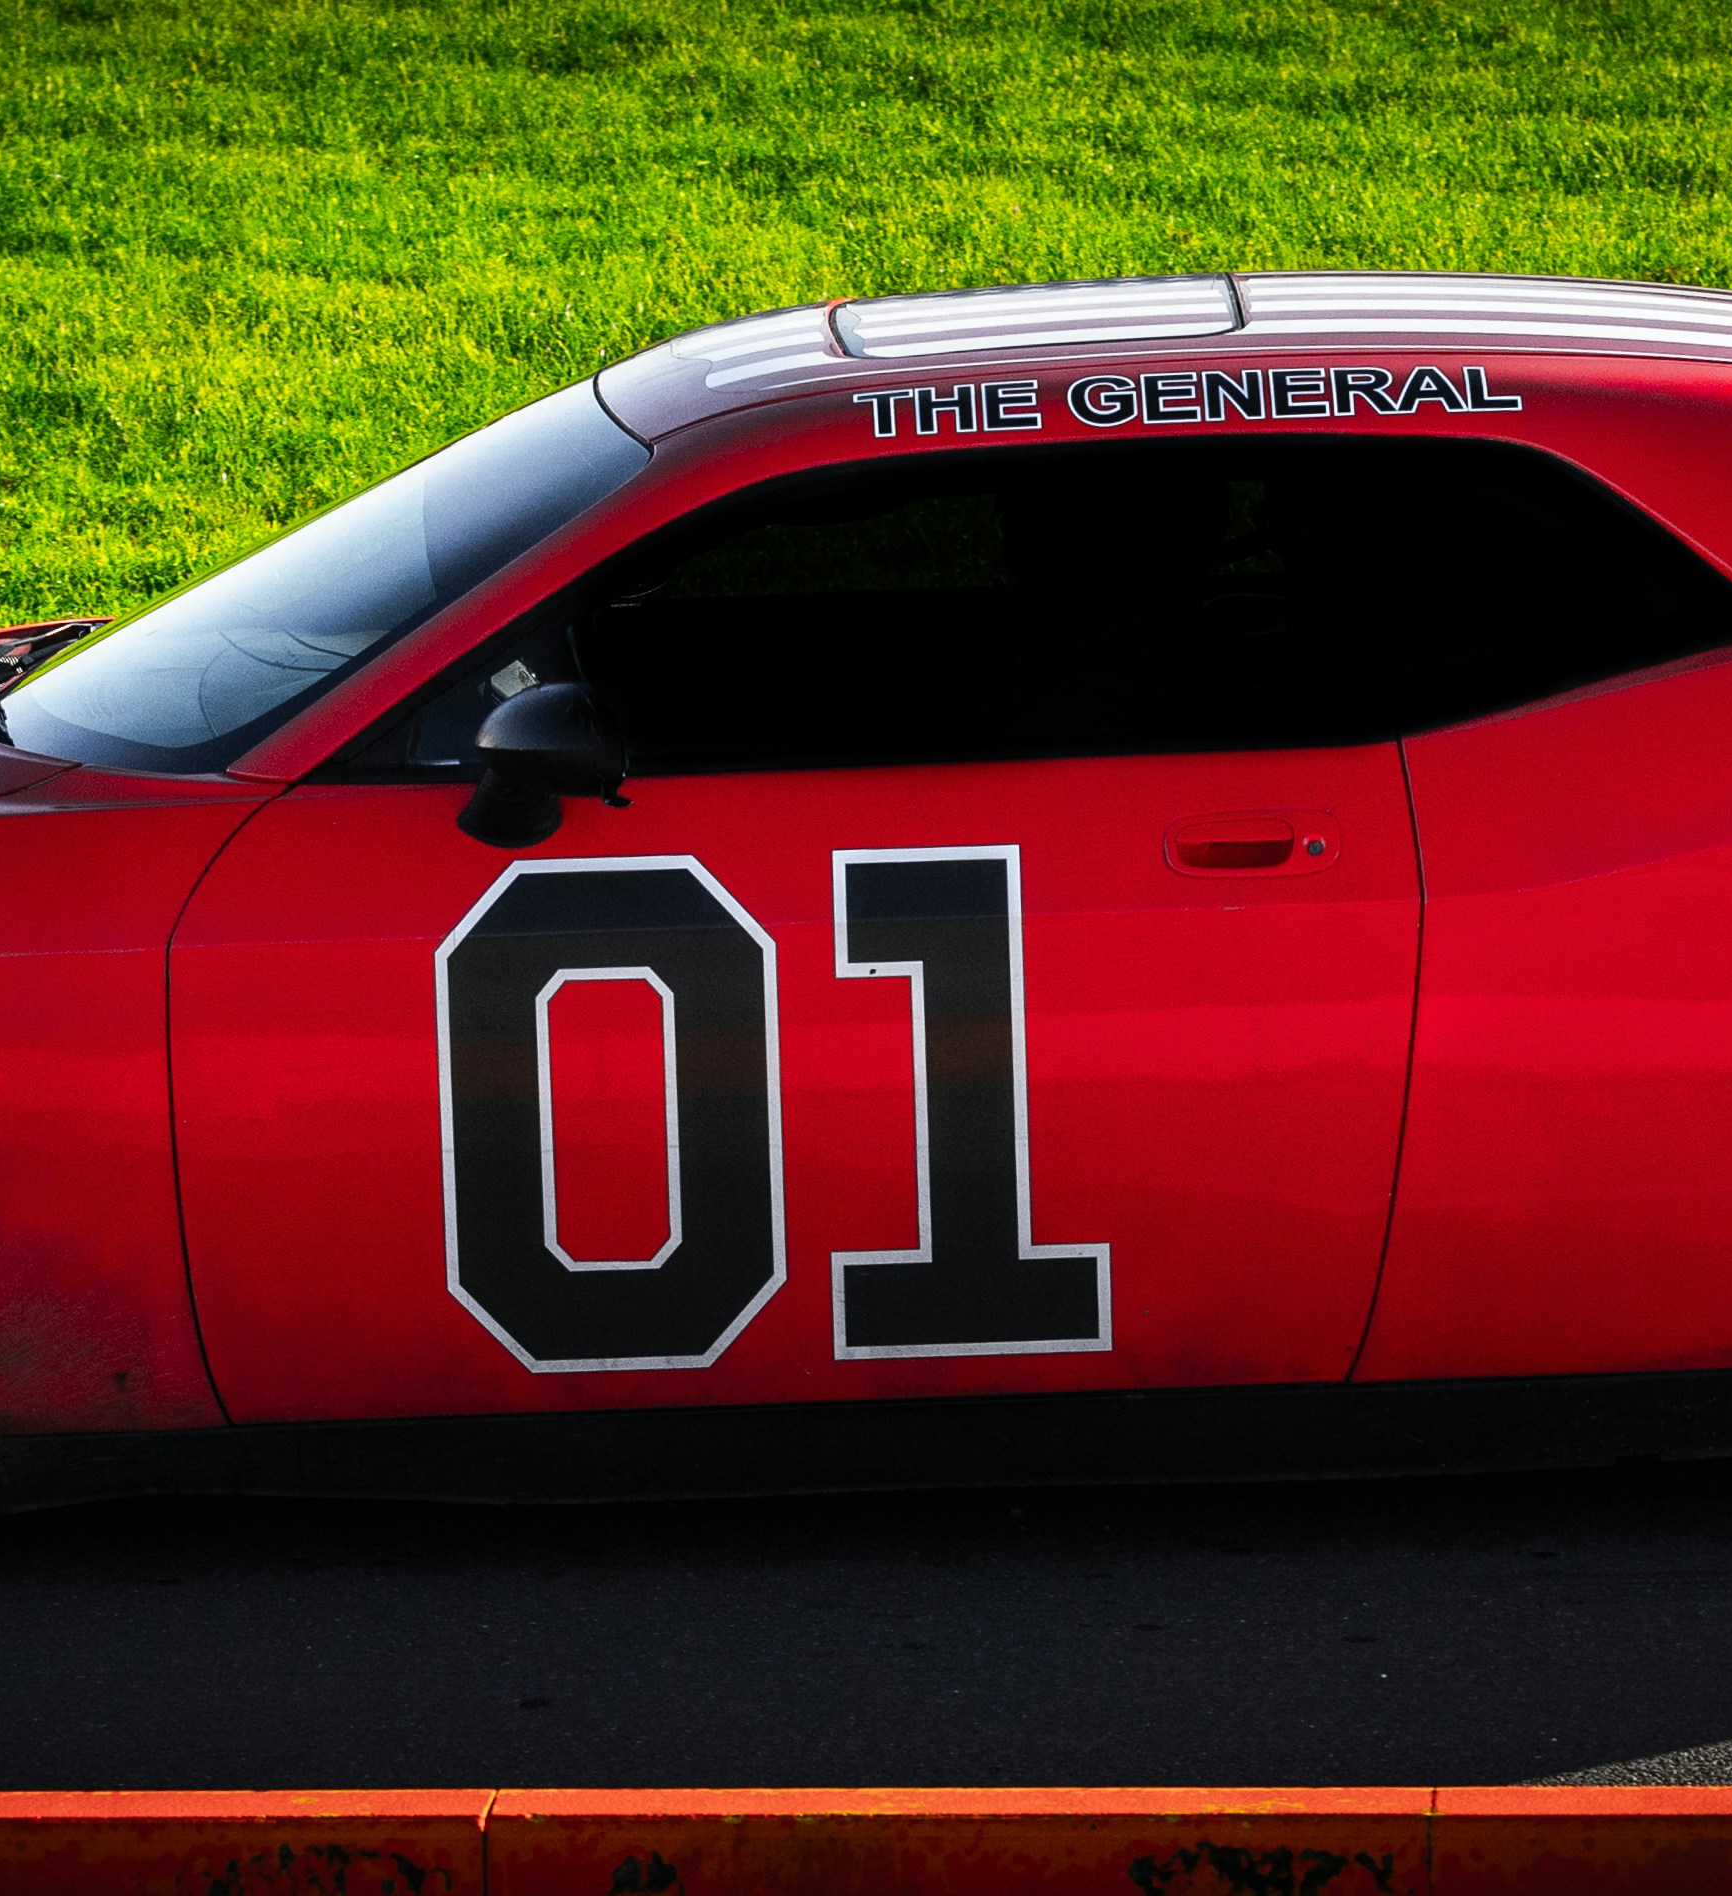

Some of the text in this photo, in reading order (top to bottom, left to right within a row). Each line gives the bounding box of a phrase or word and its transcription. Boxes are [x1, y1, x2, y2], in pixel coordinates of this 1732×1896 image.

[853, 365, 1523, 438] THE GENERAL
[433, 844, 1113, 1374] 01
